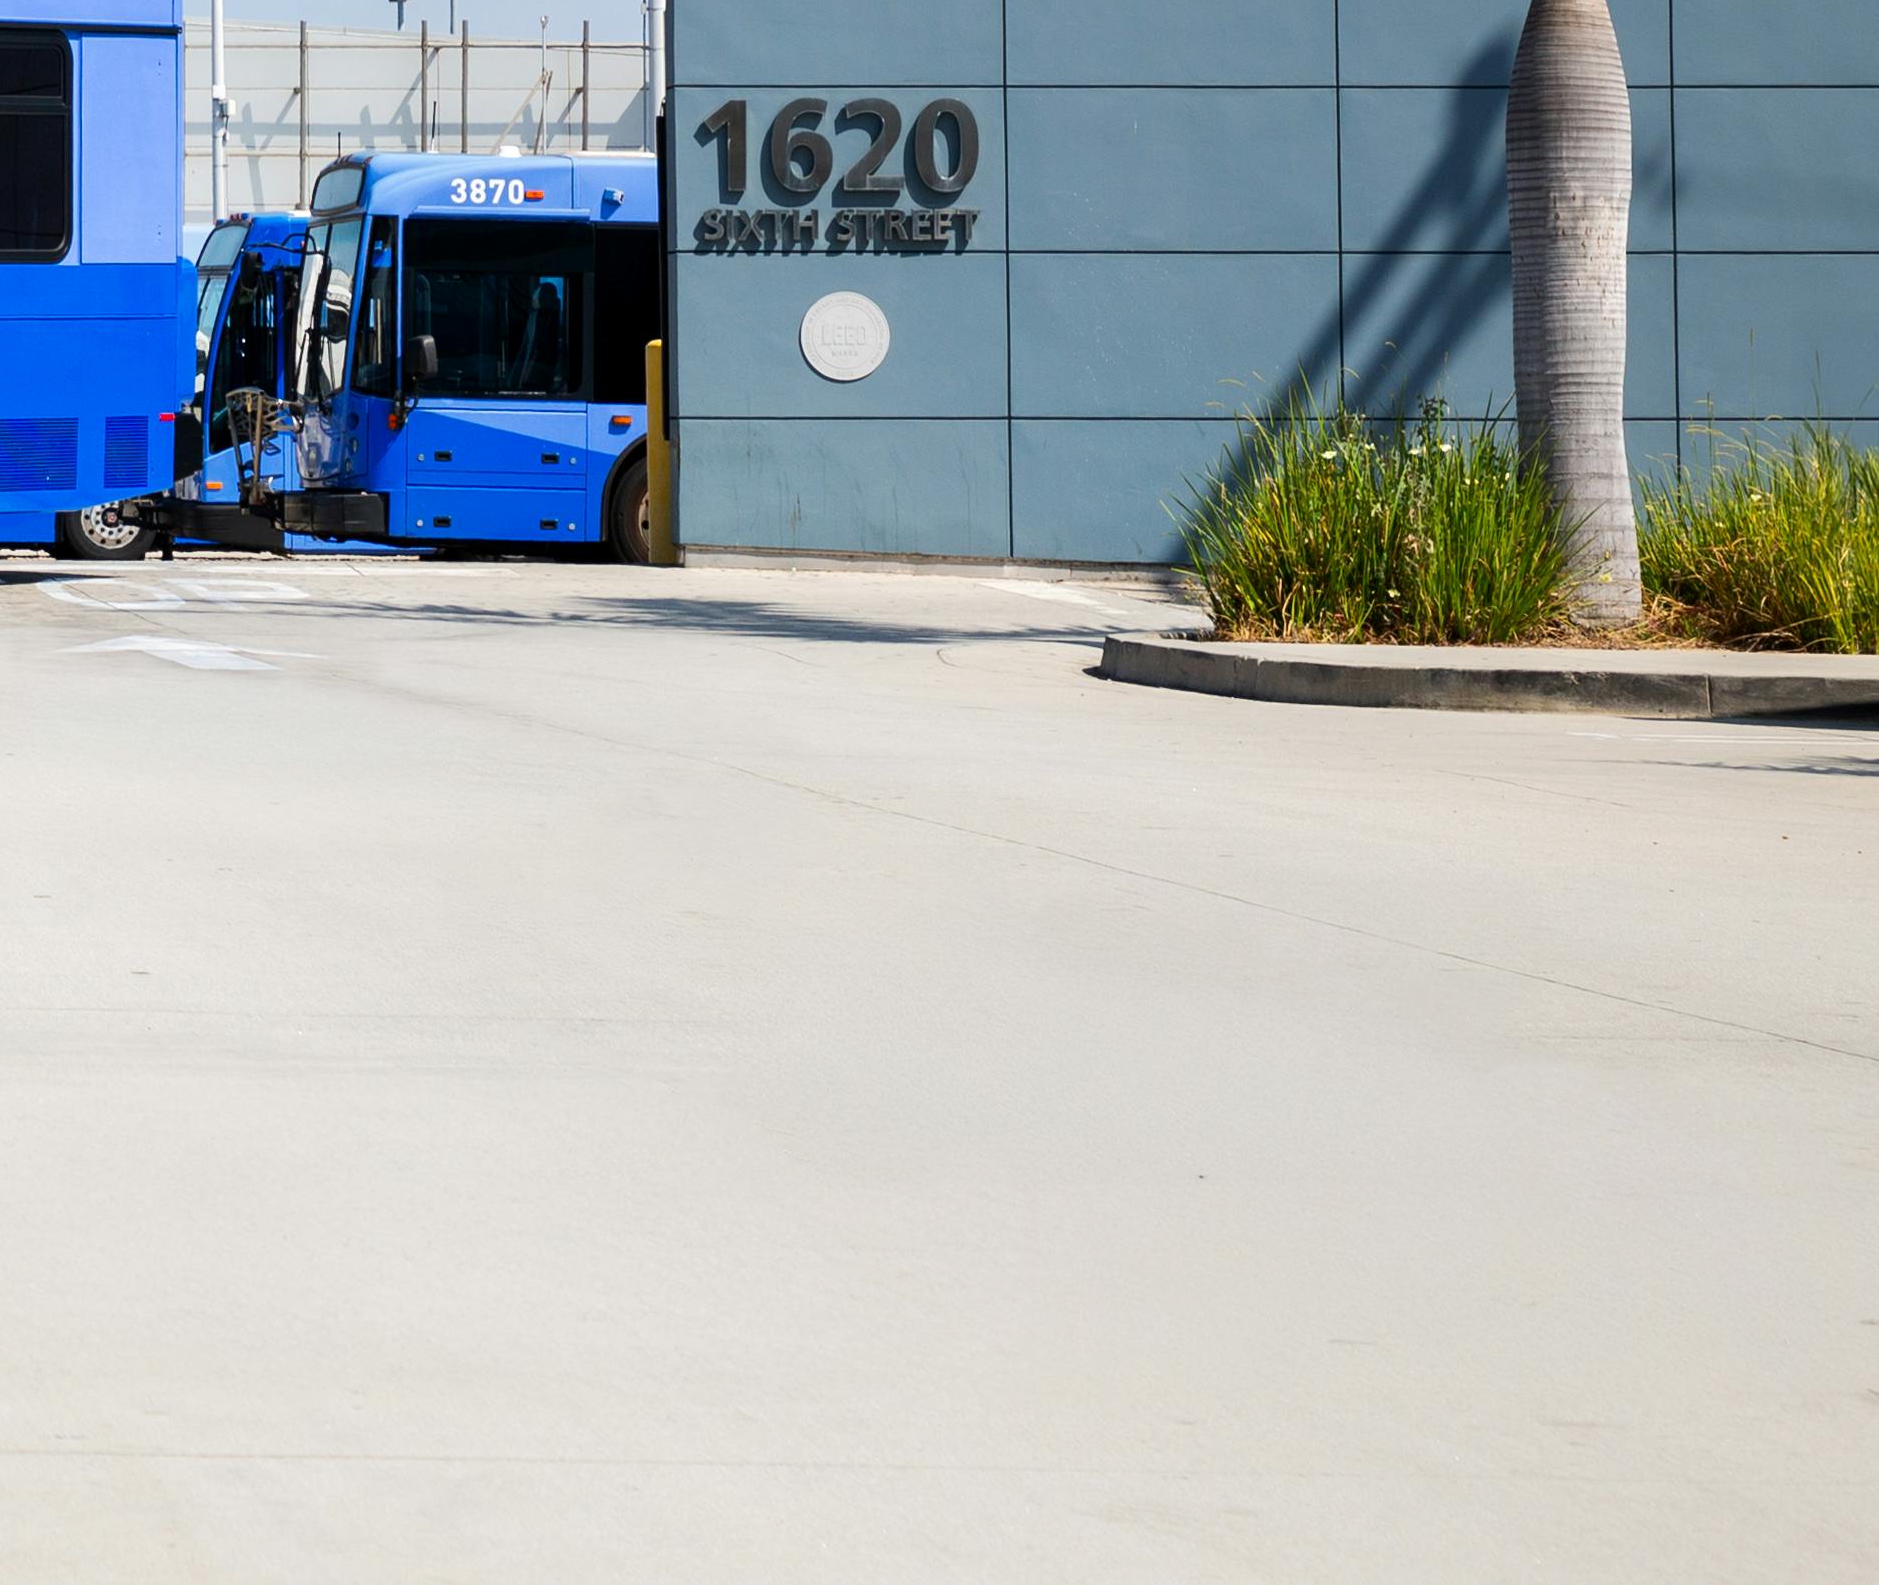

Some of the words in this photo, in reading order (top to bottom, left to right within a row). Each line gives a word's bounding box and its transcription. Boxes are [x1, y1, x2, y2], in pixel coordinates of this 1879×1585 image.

[705, 98, 979, 193] 1620
[450, 177, 525, 205] 3870
[703, 208, 820, 241] SIXTH
[836, 208, 981, 241] STREET
